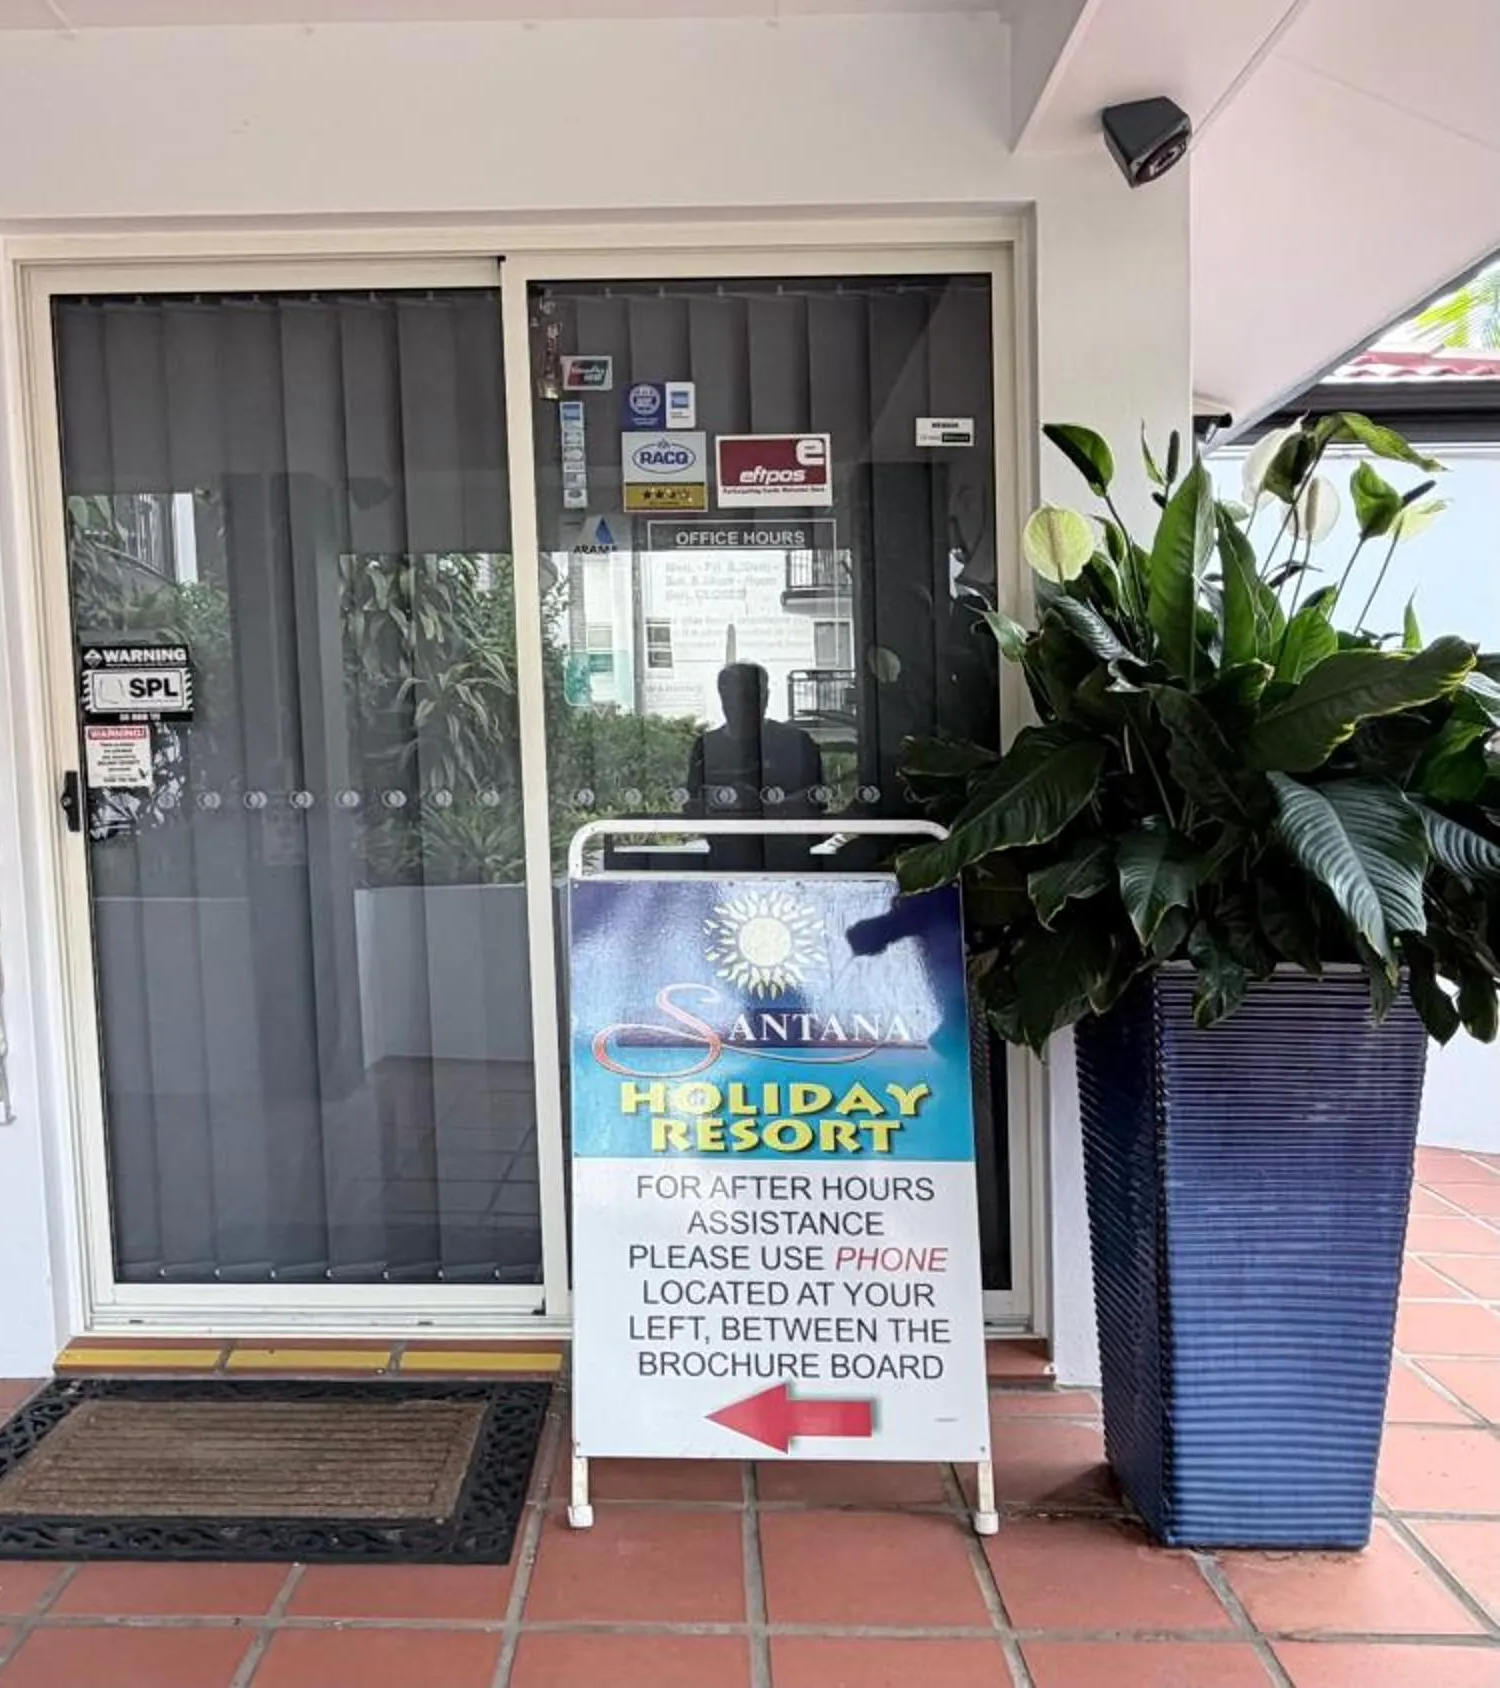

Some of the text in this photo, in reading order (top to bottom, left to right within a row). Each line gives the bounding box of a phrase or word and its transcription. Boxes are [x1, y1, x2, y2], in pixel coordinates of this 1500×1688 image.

[640, 451, 689, 465] RACQ
[740, 465, 806, 485] eftpos
[675, 531, 806, 546] OFFICE HOURS
[103, 649, 187, 664] WARNING
[129, 677, 179, 698] SPL
[592, 983, 913, 1078] SANTANA
[621, 1080, 932, 1117] HOLIDAY
[651, 1118, 905, 1153] RESORT
[637, 1175, 936, 1201] FOR AFTER HOURS
[687, 1210, 885, 1236] ASSISTANCE
[629, 1244, 950, 1272] PLEASE USE PHONE
[642, 1280, 936, 1307] LOCATED AT YOUR
[629, 1315, 951, 1344] LEFT, BETWEEN THE
[638, 1351, 945, 1380] BROCHURE BOARD
